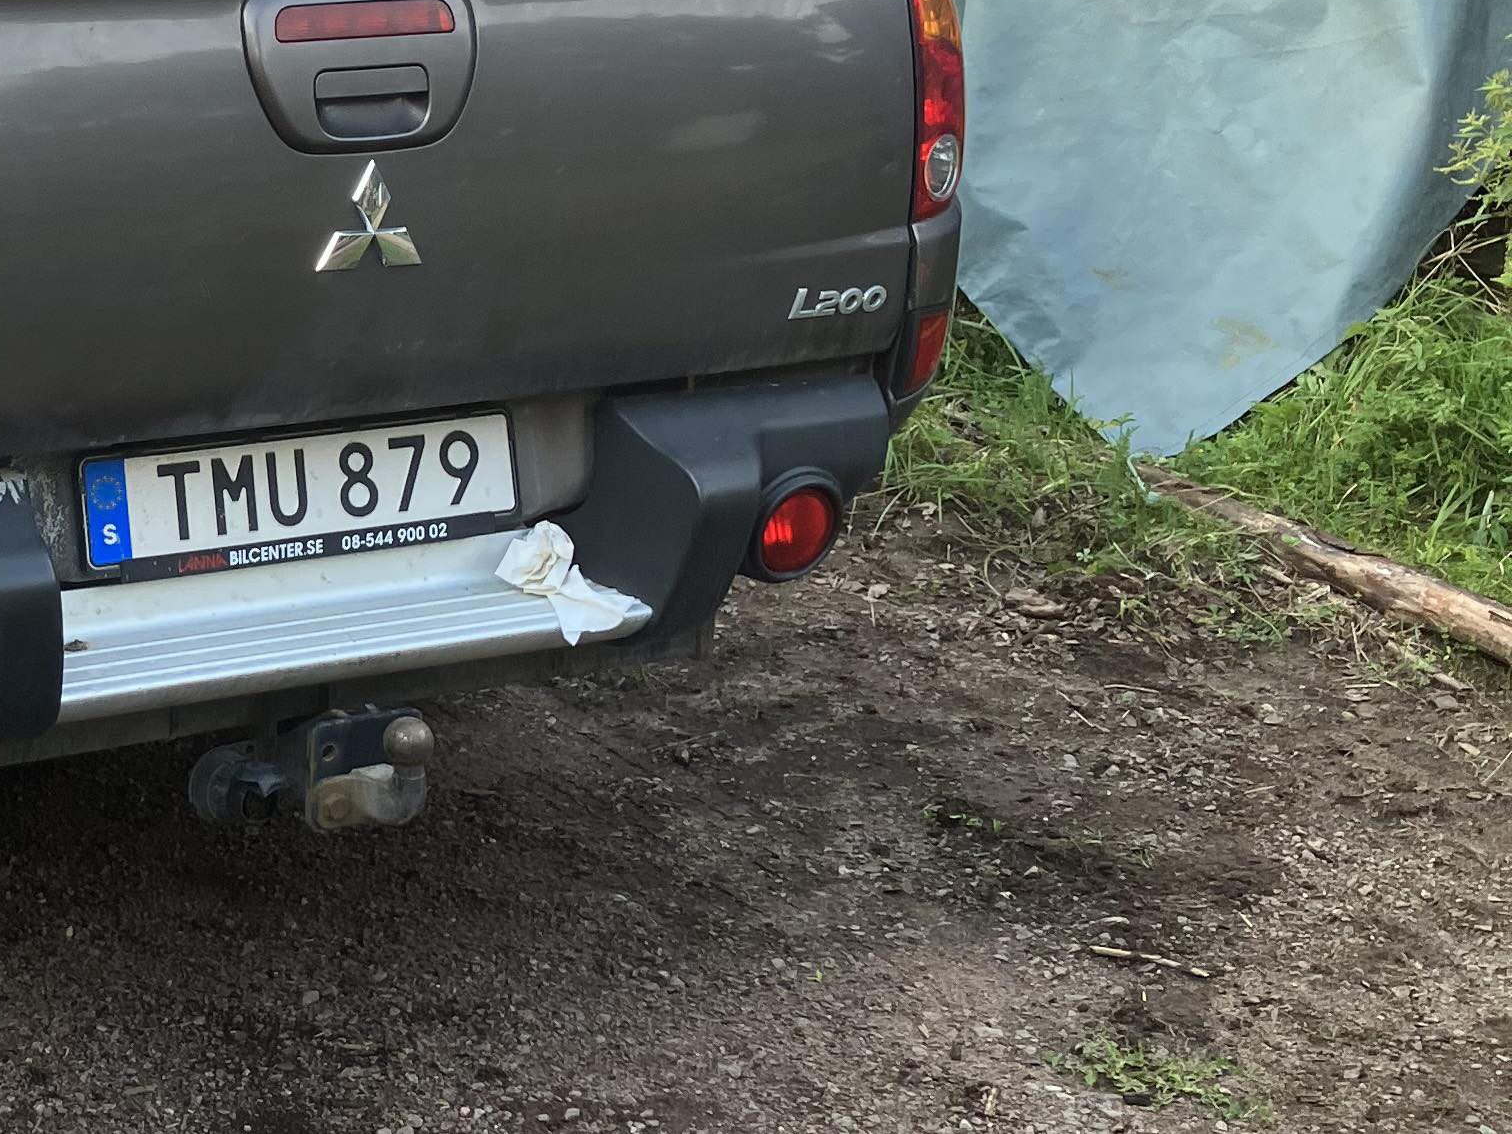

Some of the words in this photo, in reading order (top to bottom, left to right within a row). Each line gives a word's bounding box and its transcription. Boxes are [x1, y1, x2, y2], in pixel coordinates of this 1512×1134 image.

[787, 285, 888, 320] L200
[157, 448, 308, 541] TMU
[338, 429, 480, 517] 879
[102, 523, 118, 546] S
[341, 530, 394, 551] 08-544
[397, 526, 426, 544] 900
[428, 522, 448, 539] 02
